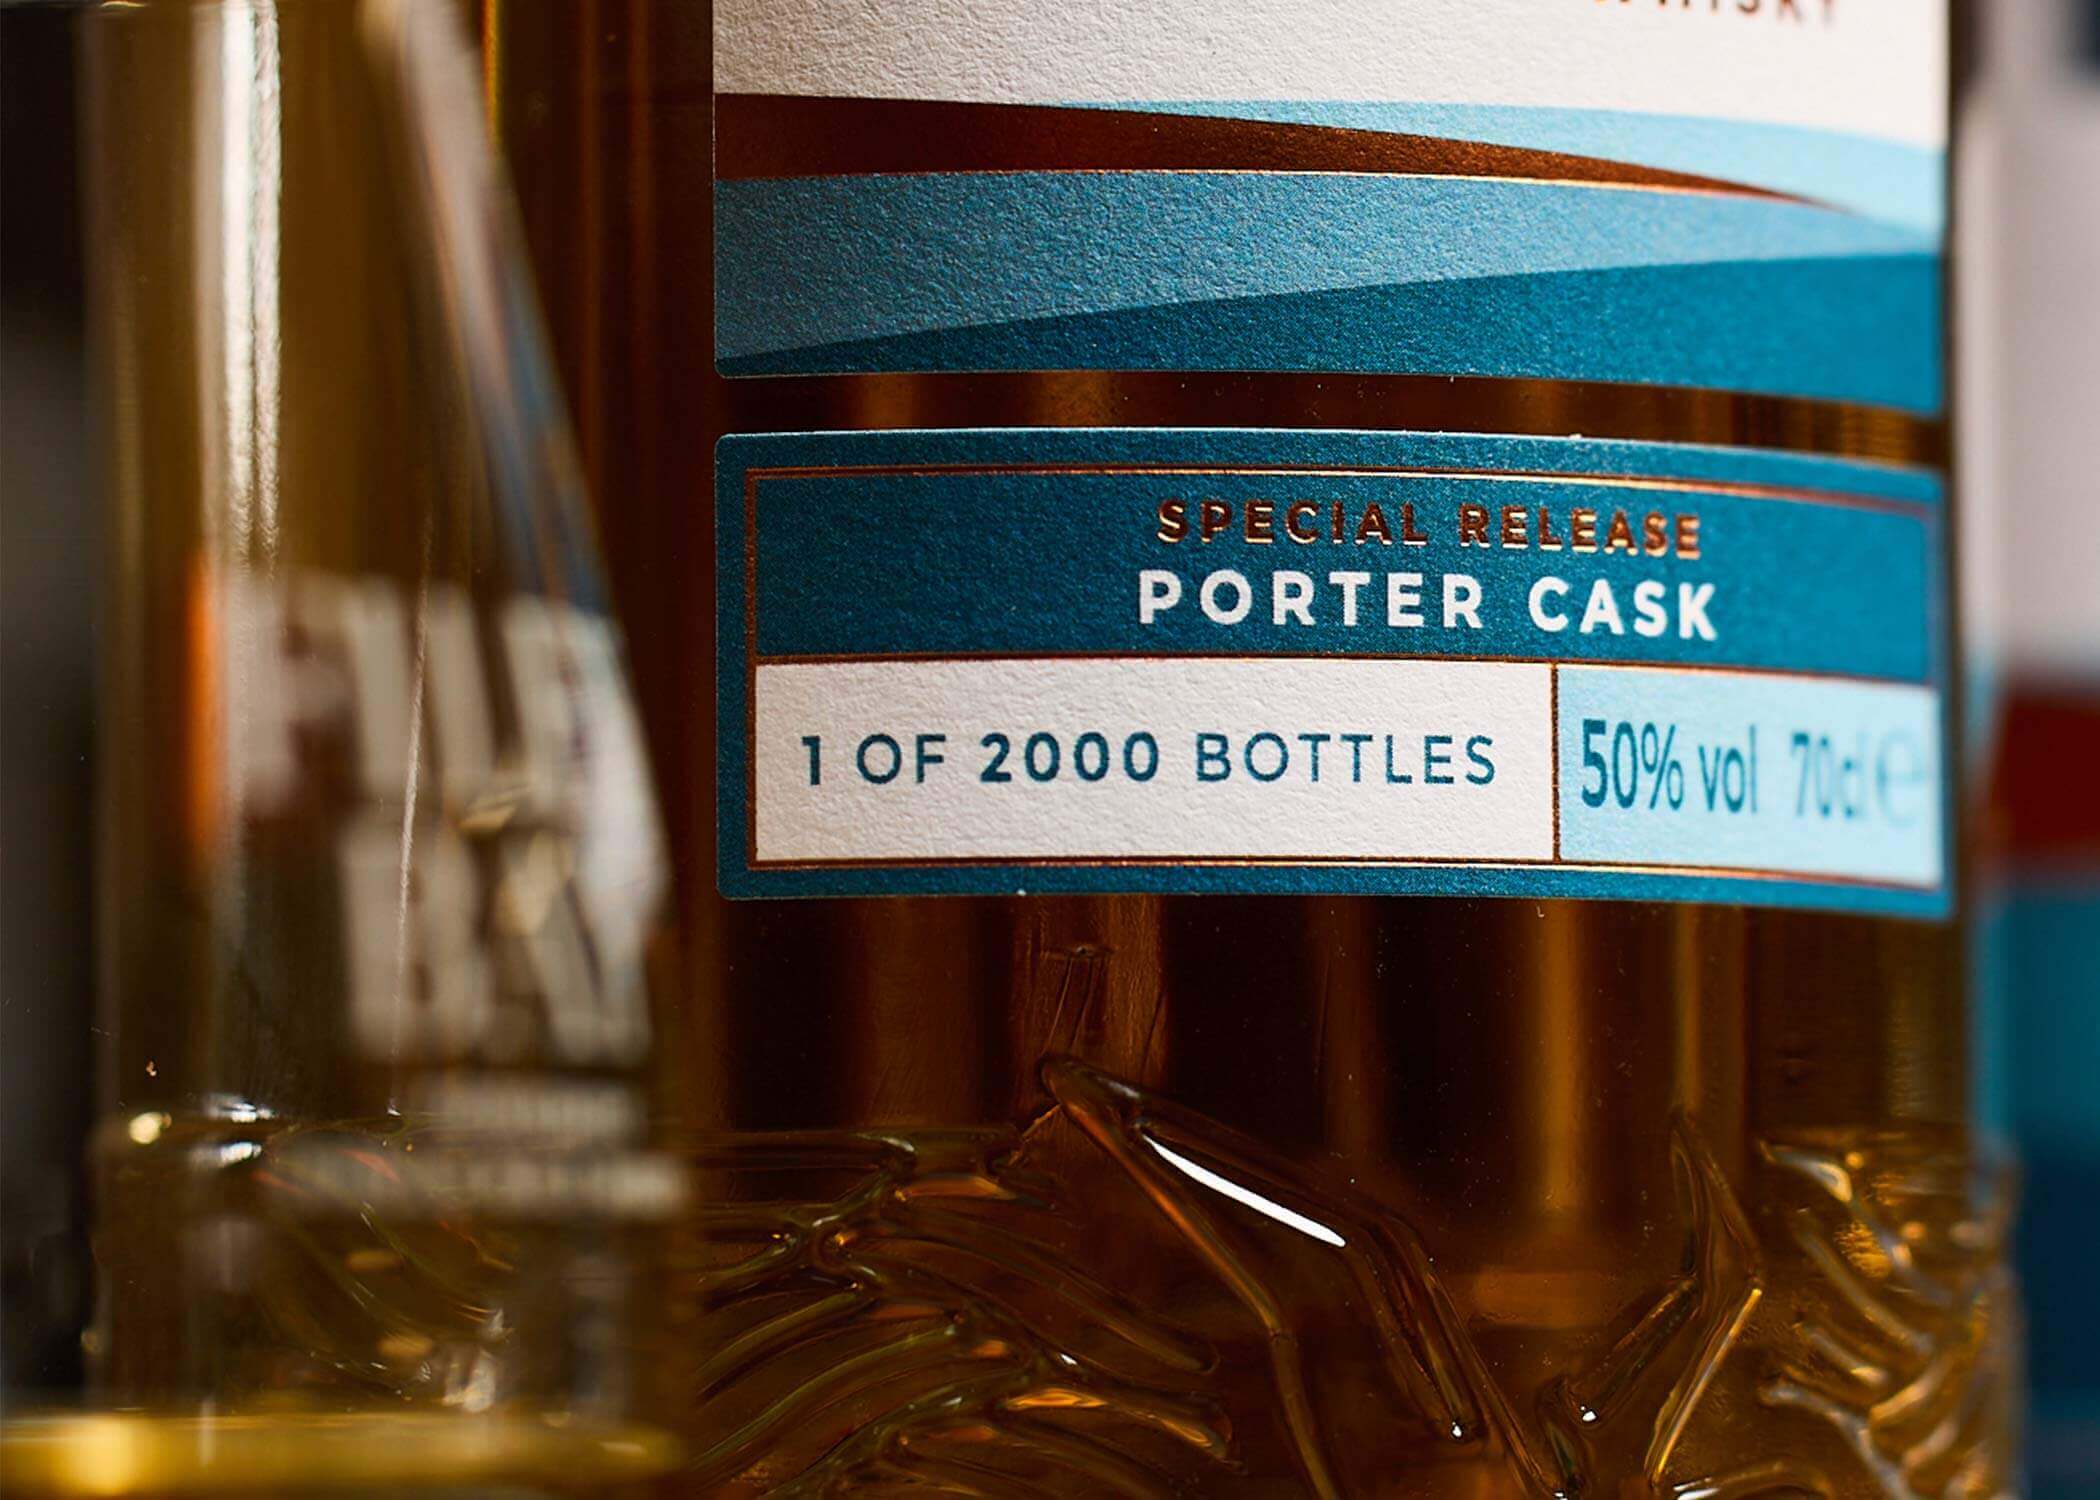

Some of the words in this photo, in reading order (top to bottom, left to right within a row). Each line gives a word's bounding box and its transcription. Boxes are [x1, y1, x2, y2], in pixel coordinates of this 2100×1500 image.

[1157, 501, 1427, 545] SPECIAL
[1458, 503, 1702, 559] RELEASE
[1138, 569, 1484, 628] PORTER
[1528, 577, 1718, 640] CASK
[801, 735, 822, 785] 1
[856, 734, 947, 785] OF
[980, 732, 1159, 783] 2000
[1195, 734, 1496, 785] BOTTLES
[1581, 718, 1684, 811] 50%
[1697, 724, 1757, 814] vol
